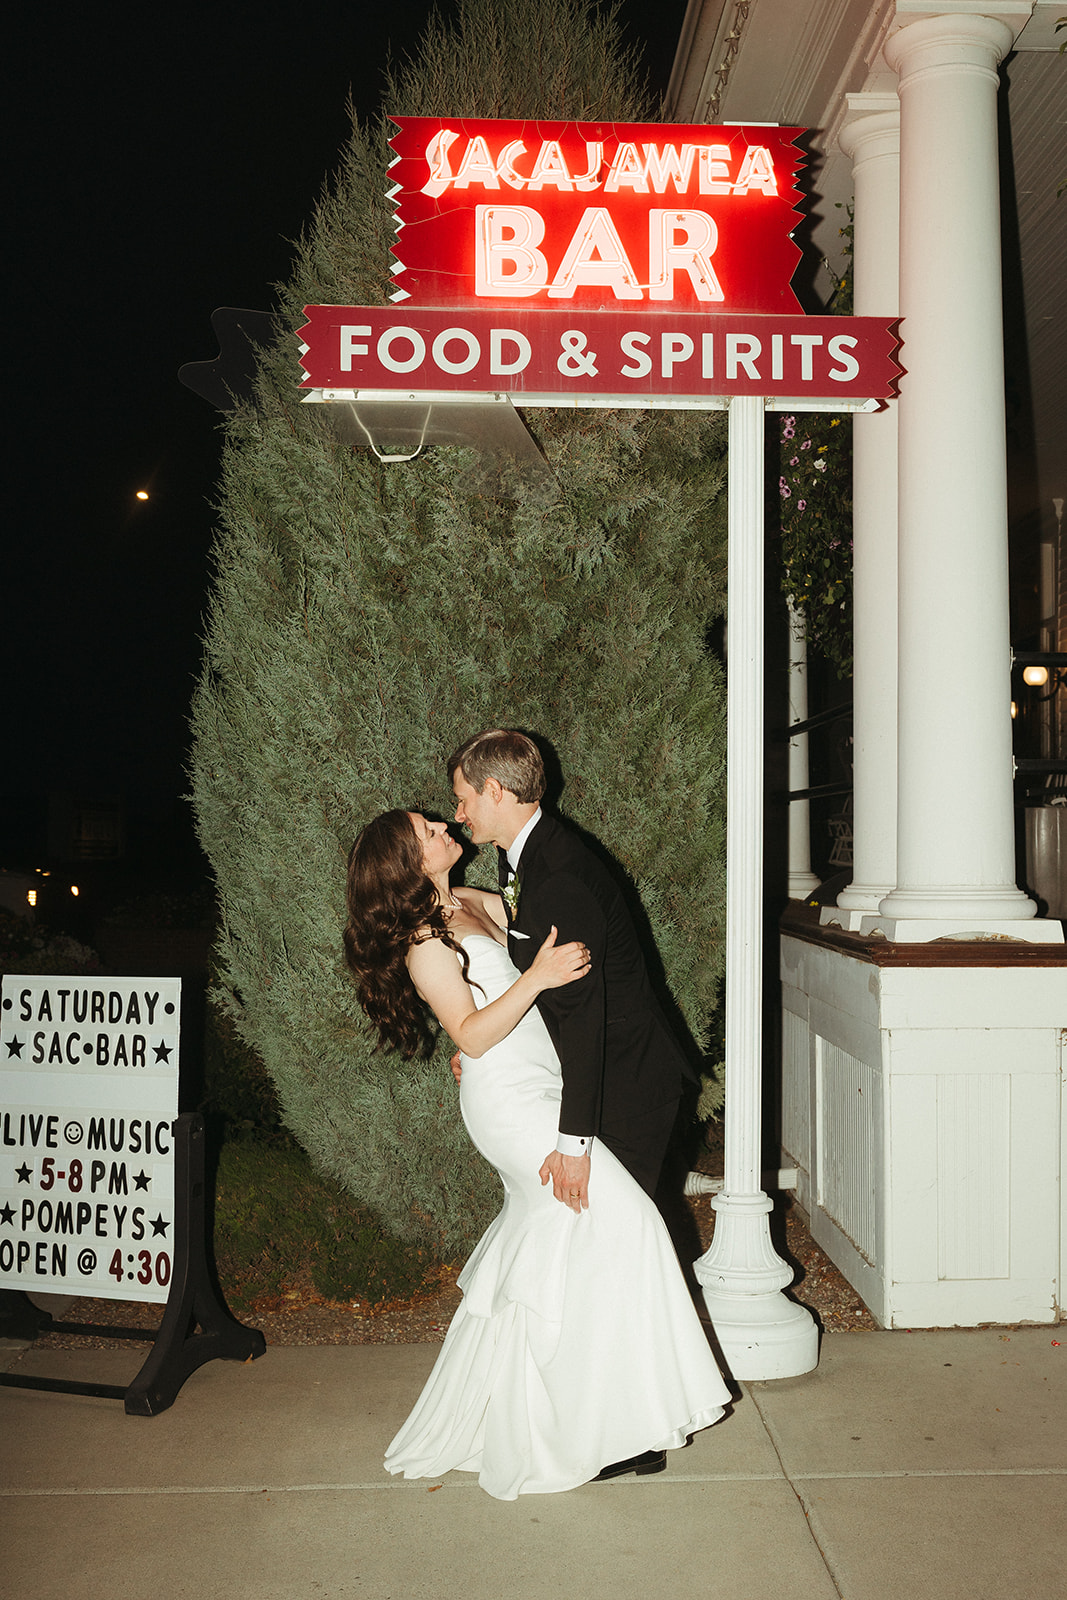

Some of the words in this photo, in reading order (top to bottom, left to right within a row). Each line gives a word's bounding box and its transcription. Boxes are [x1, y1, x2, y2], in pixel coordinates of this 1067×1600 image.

[421, 128, 779, 197] SACAJAWEA
[474, 204, 725, 301] BAR
[340, 325, 532, 375] FOOD
[557, 330, 599, 377] &
[620, 331, 860, 382] SPIRITS
[20, 989, 160, 1025] SATURDAY
[3, 1112, 59, 1148] LIVE
[87, 1117, 170, 1155] MUSIC
[40, 1157, 83, 1193] 5-8
[91, 1160, 128, 1196] PM
[21, 1199, 145, 1241] POMPEYS
[0, 1239, 67, 1277] OPEN
[77, 1248, 98, 1275] @
[109, 1248, 171, 1286] 4:30
